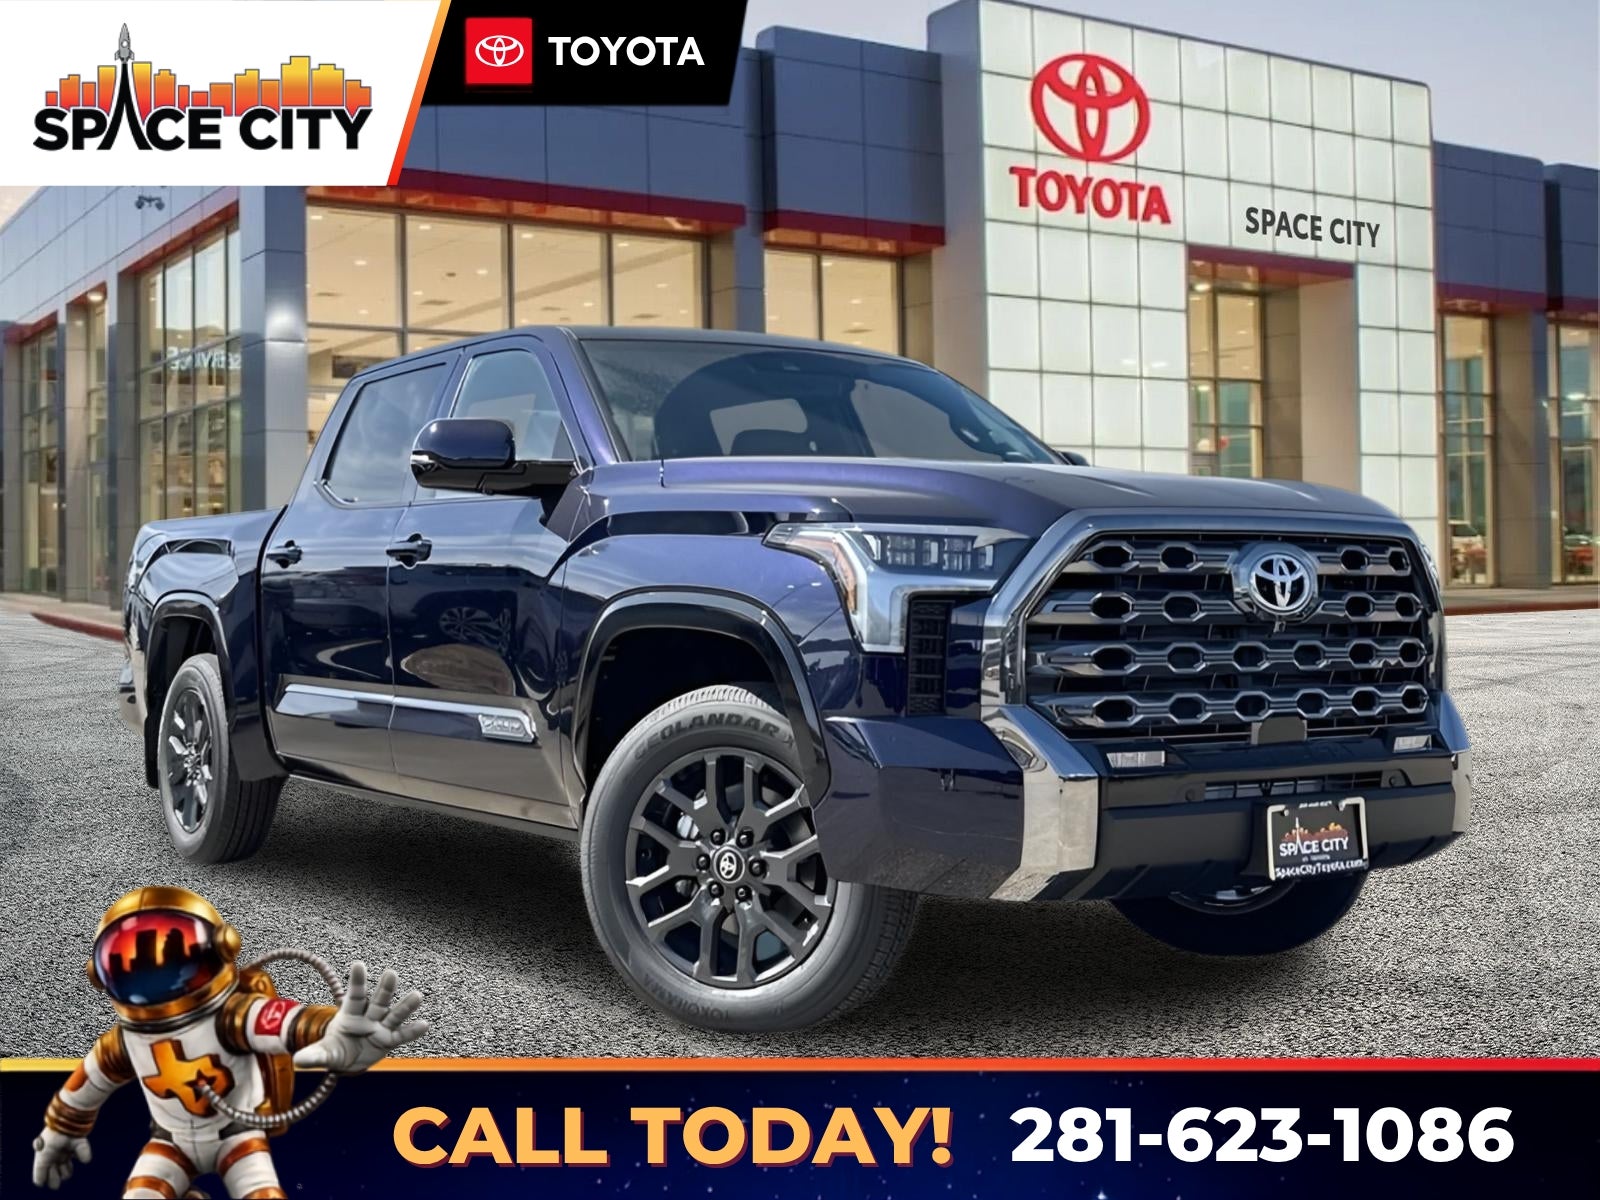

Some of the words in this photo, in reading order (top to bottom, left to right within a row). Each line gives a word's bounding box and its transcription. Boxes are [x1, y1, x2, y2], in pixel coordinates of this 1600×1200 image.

[1009, 166, 1172, 225] TOYOTA
[1245, 206, 1323, 242] SPACE
[1329, 218, 1381, 248] CITY
[1279, 839, 1320, 857] SPACE
[1321, 836, 1350, 852] CITY
